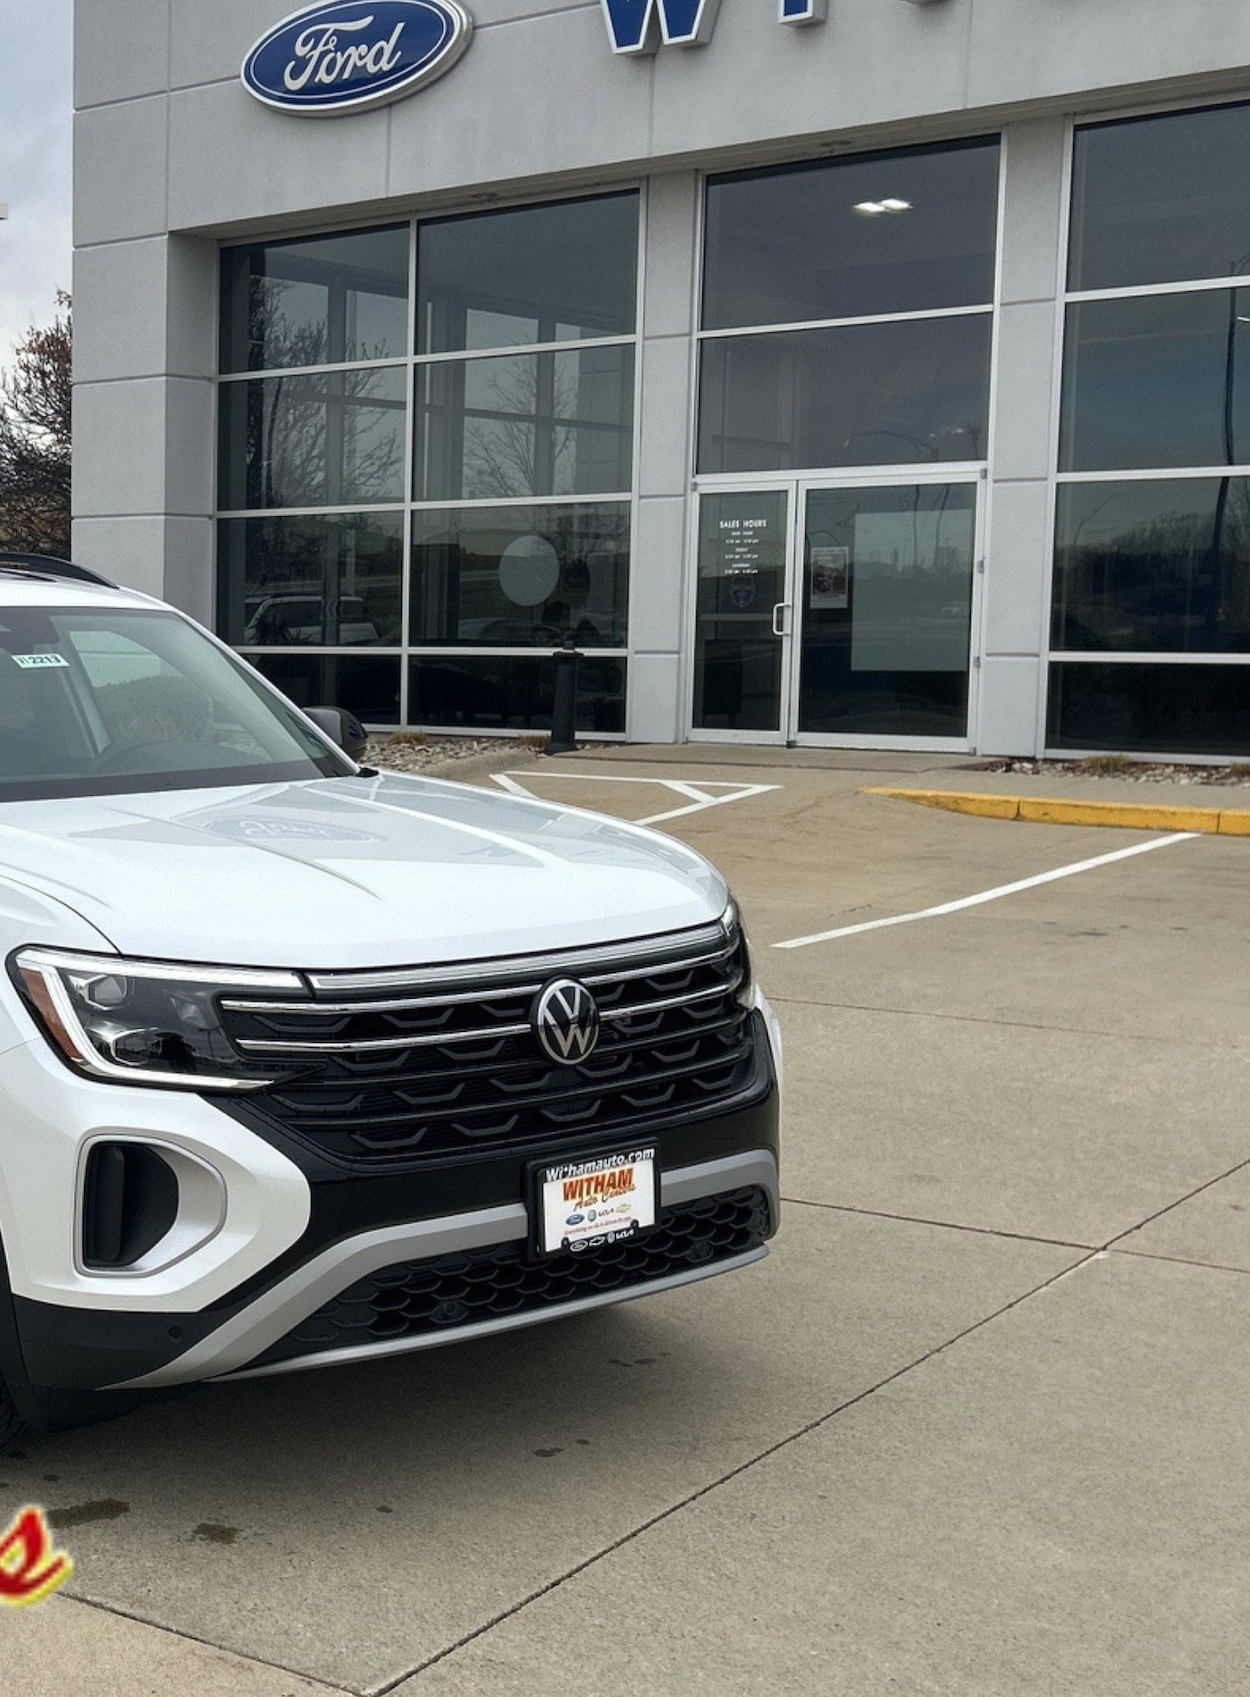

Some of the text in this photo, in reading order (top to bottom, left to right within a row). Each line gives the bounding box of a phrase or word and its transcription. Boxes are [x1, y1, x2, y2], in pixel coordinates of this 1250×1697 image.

[283, 15, 405, 90] Ford
[719, 519, 767, 529] SALES HOURS
[562, 1167, 635, 1203] WITHAM
